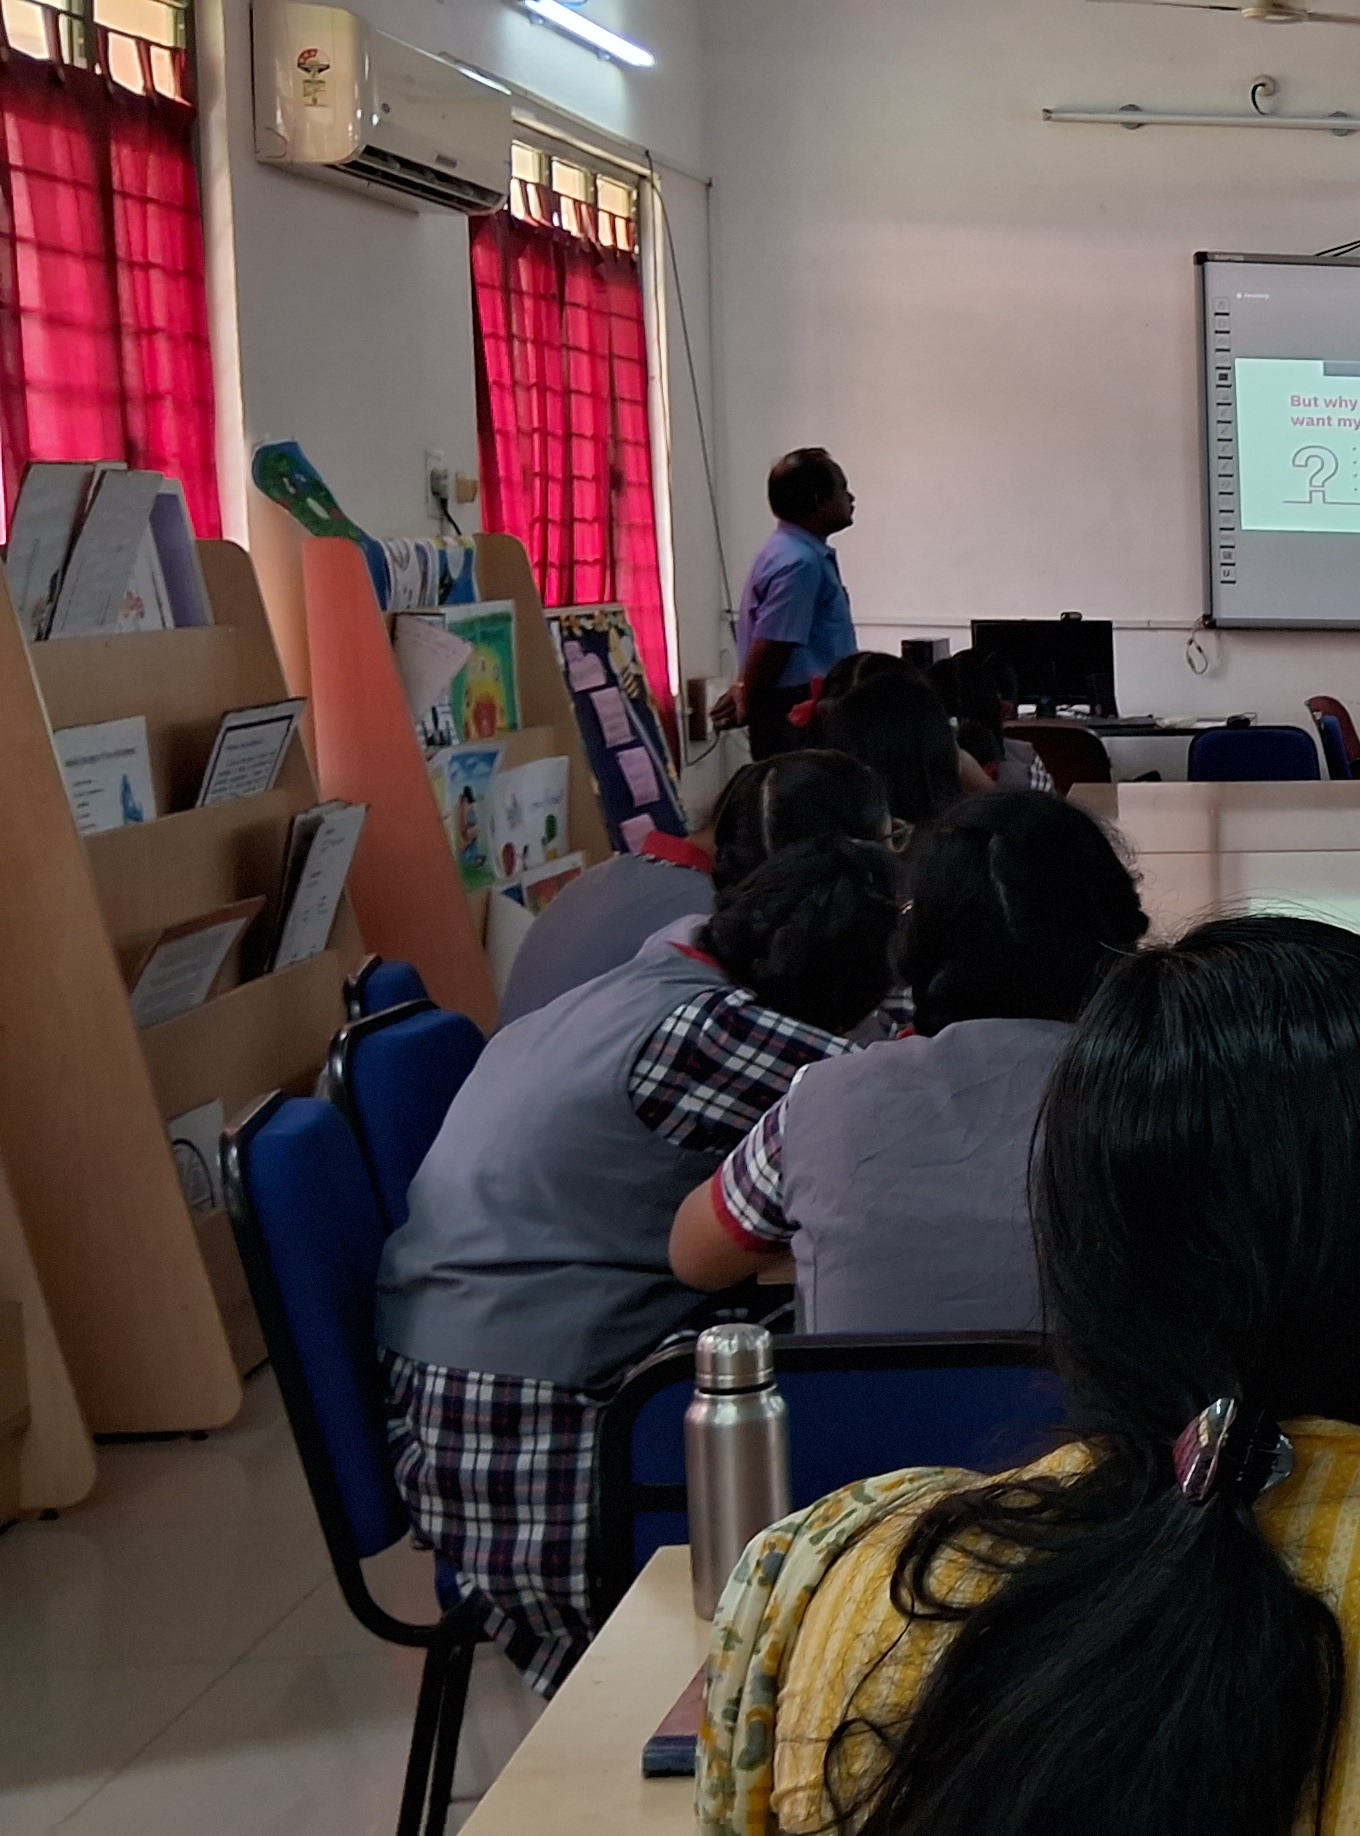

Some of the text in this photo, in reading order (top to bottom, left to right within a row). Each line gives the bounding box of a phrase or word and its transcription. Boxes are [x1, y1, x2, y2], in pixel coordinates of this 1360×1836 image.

[1290, 394, 1319, 408] But
[1323, 396, 1358, 412] why
[1291, 415, 1333, 427] want
